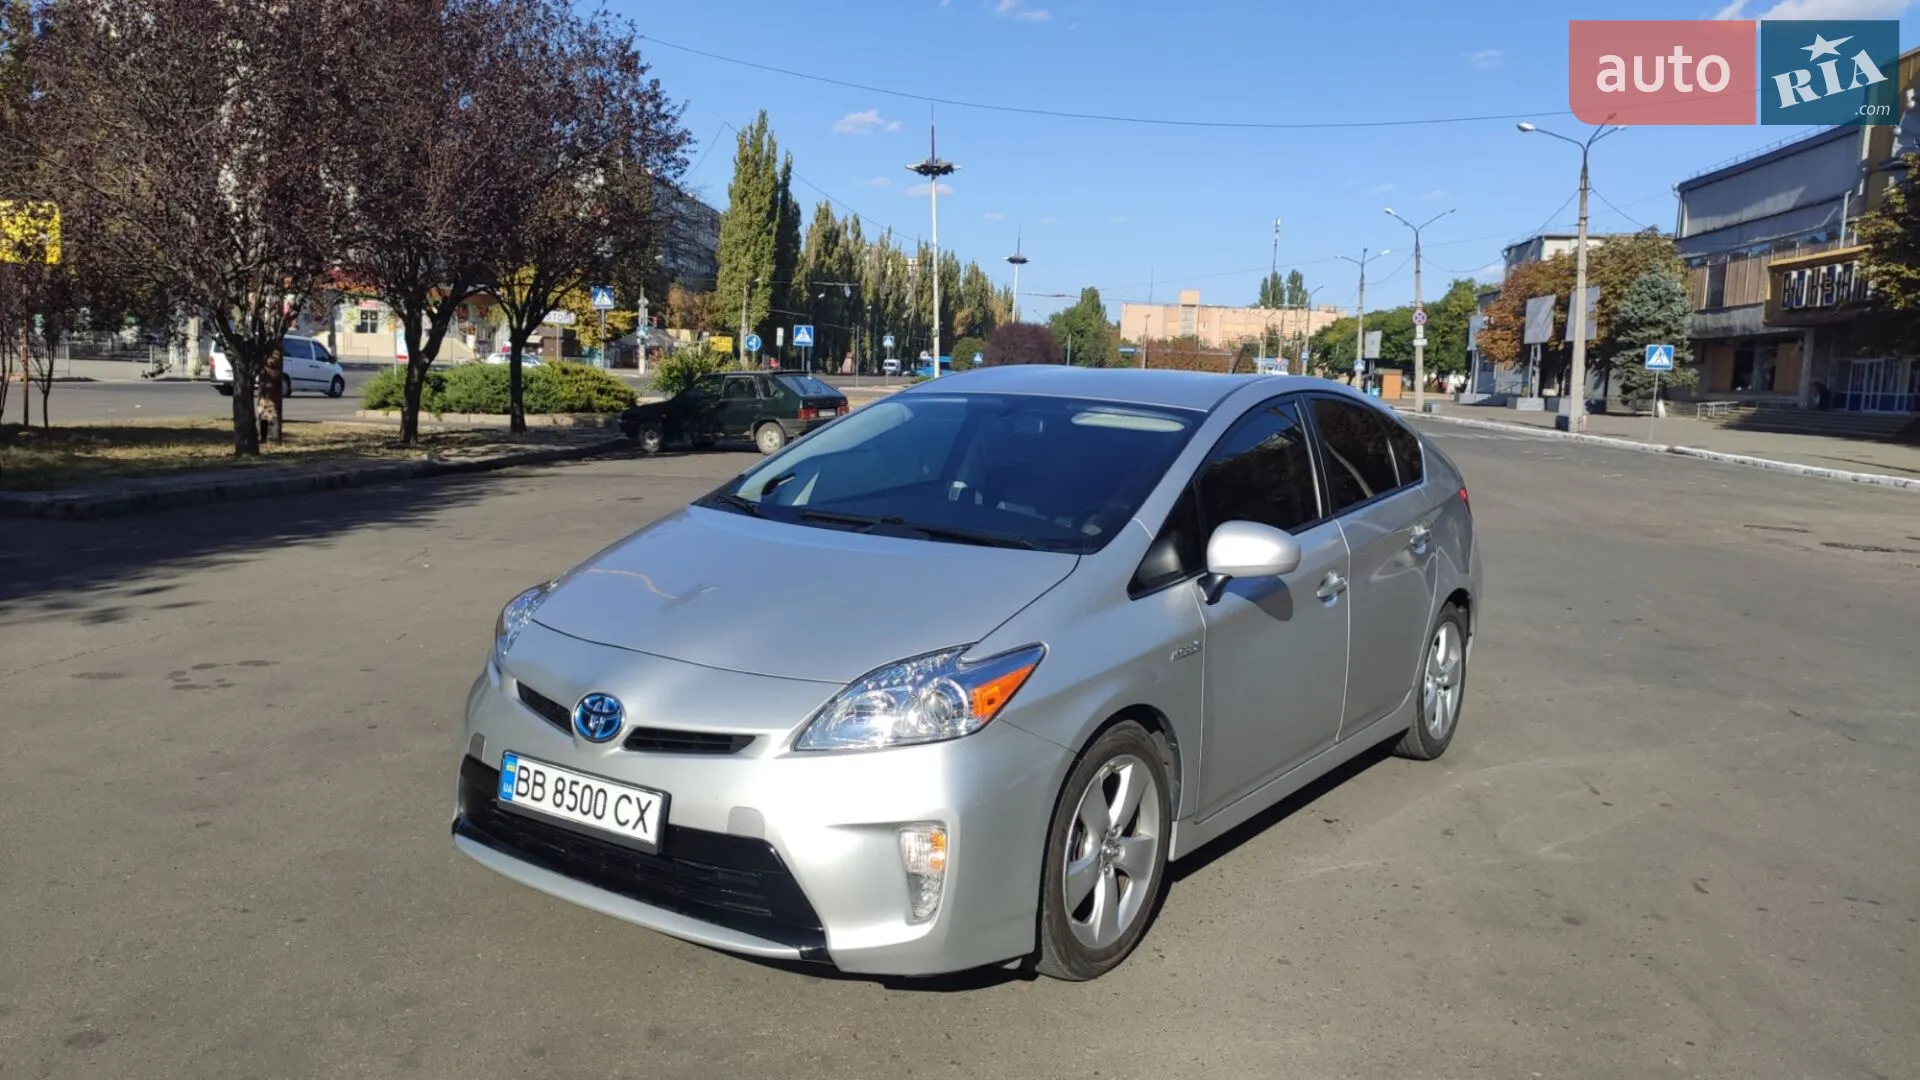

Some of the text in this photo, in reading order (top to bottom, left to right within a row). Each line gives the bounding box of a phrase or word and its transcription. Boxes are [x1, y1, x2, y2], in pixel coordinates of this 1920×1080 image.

[503, 782, 513, 793] UA
[515, 765, 652, 834] BB 8500 CX
